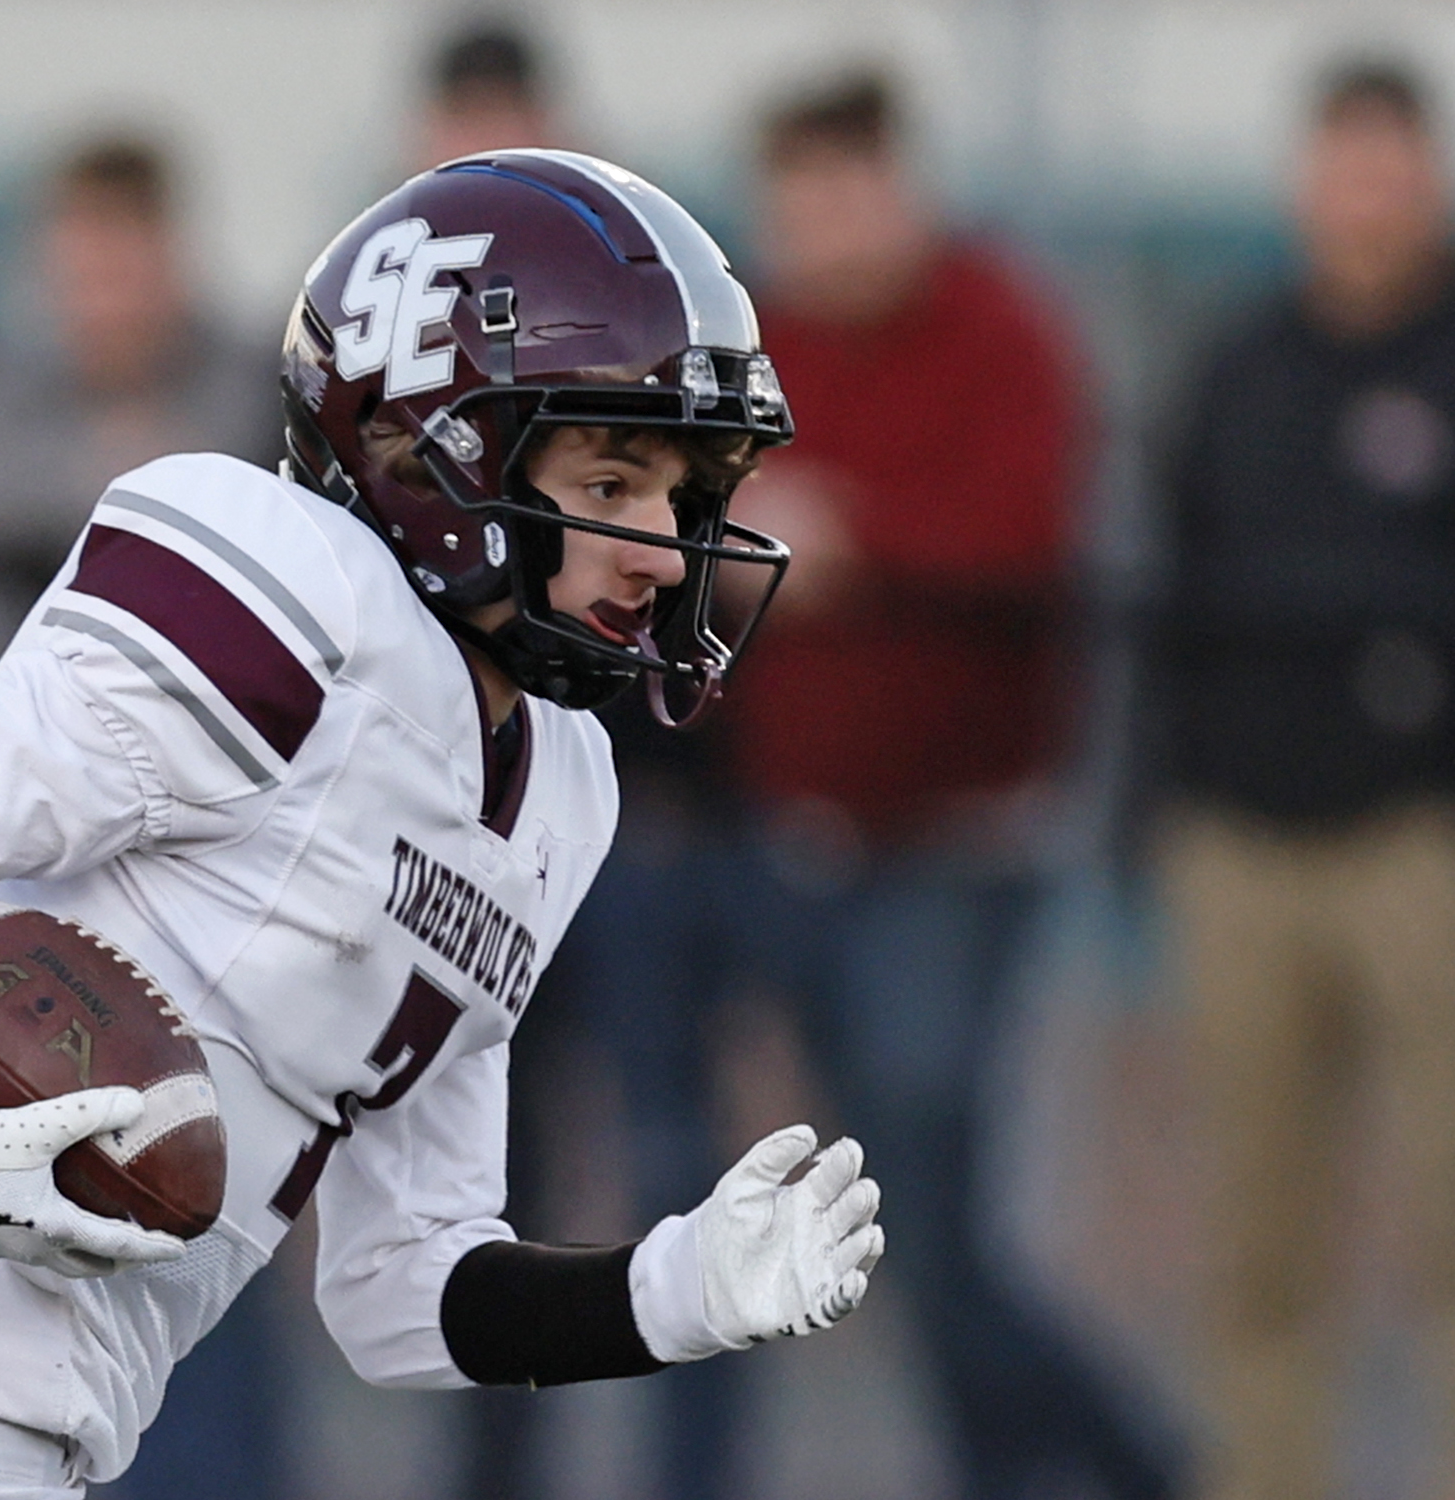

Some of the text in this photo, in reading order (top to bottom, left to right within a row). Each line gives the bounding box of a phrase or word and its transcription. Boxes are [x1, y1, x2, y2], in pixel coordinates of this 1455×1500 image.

[334, 217, 494, 401] SE
[25, 945, 120, 1028] SPALDING
[383, 833, 537, 1018] TIMBERWOLVES
[266, 962, 469, 1226] 7
